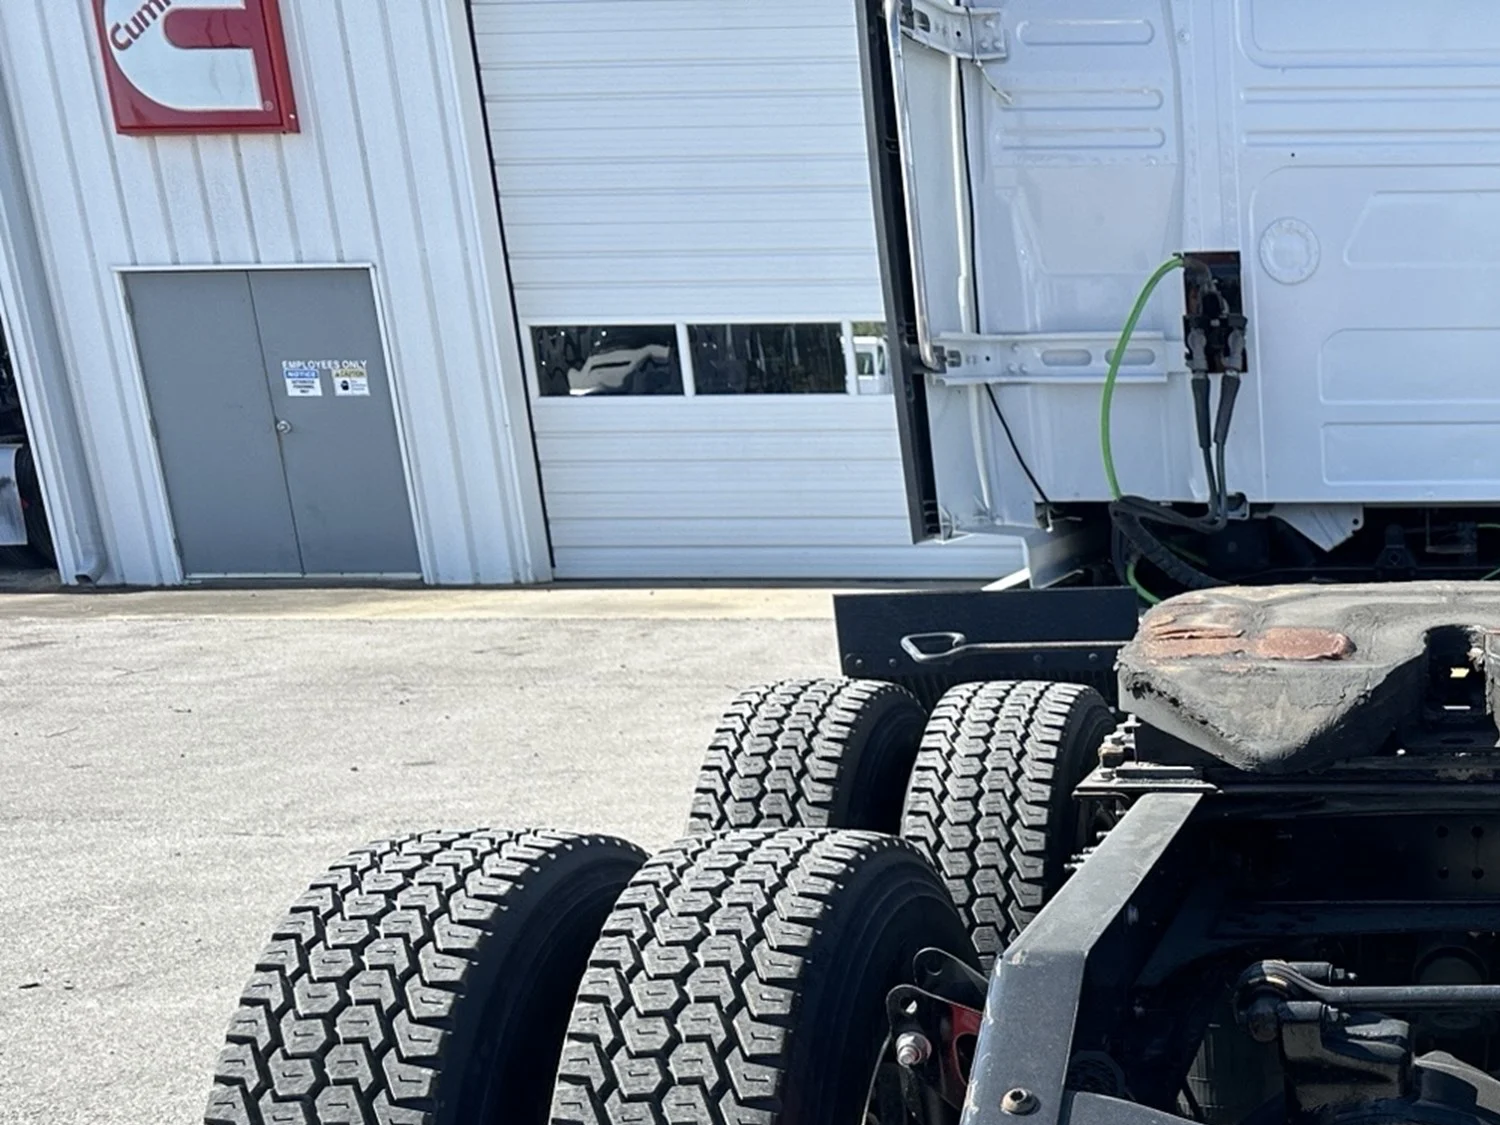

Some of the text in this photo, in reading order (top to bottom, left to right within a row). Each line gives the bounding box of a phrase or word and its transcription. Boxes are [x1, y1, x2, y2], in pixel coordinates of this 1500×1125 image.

[110, 0, 171, 51] Cum
[282, 360, 367, 370] EMPLOYEES ONLY
